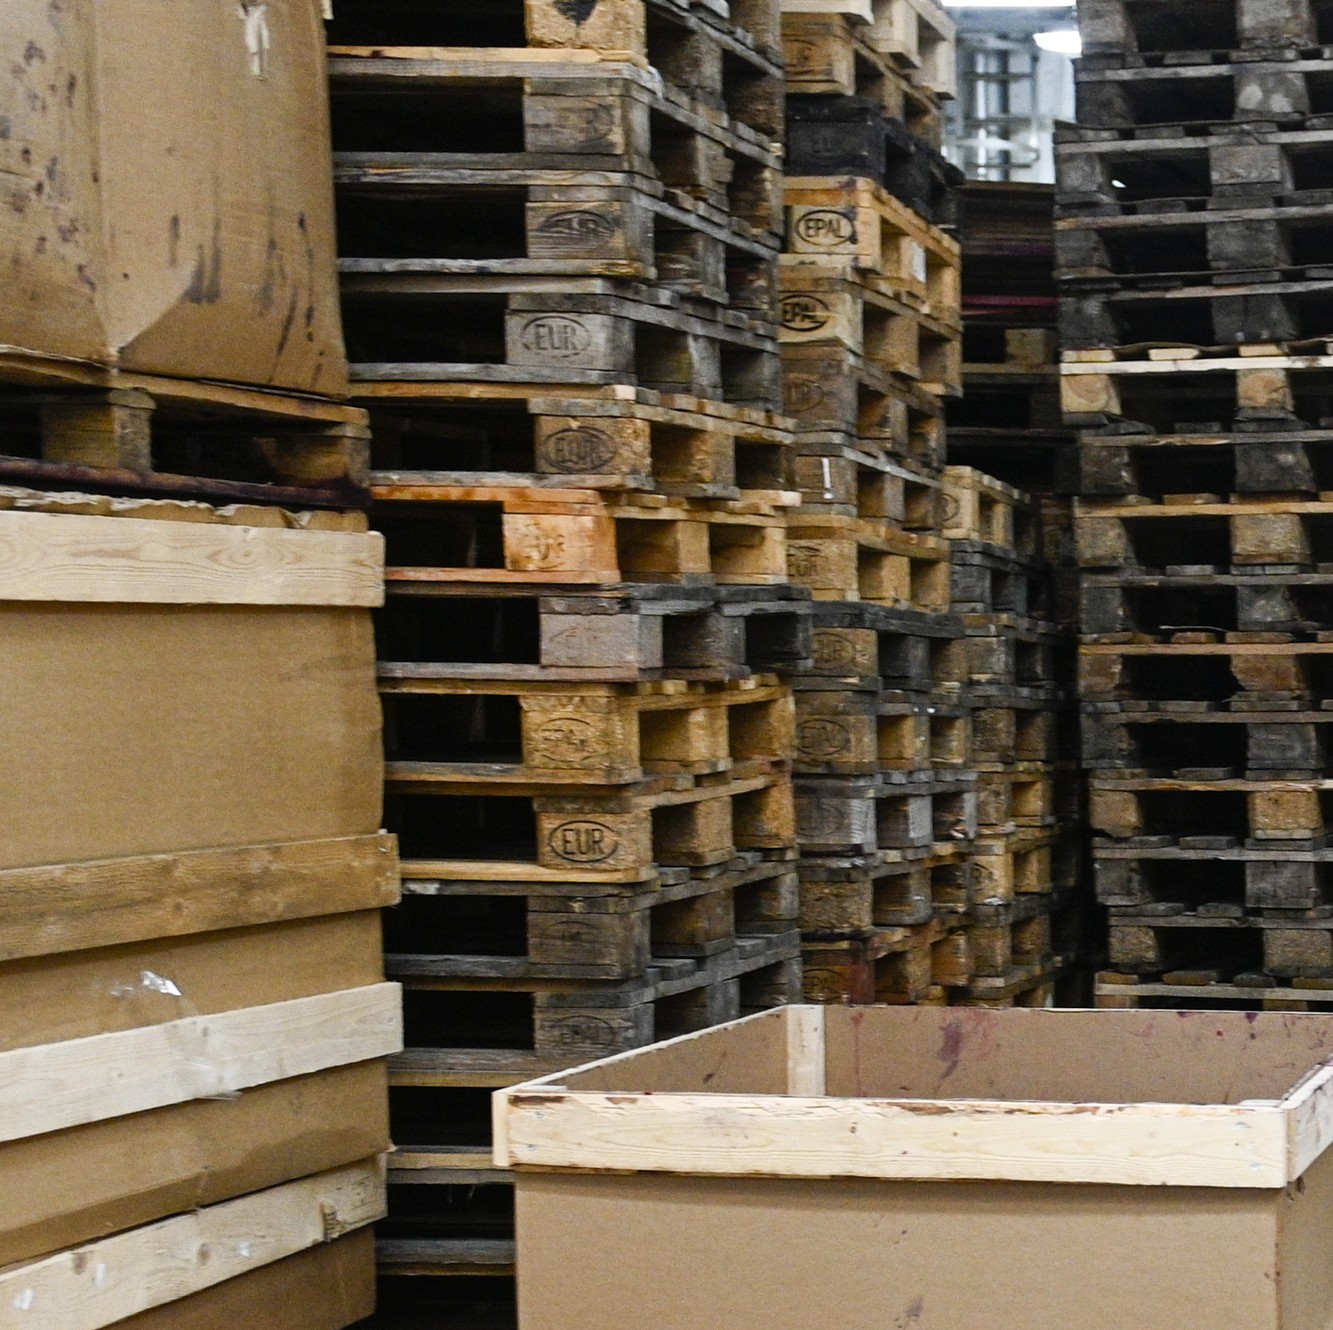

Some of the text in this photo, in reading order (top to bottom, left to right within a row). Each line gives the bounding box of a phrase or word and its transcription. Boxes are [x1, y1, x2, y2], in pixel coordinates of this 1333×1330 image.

[804, 217, 845, 239] EPAL
[533, 323, 580, 351] EUR
[561, 827, 605, 855] EUR
